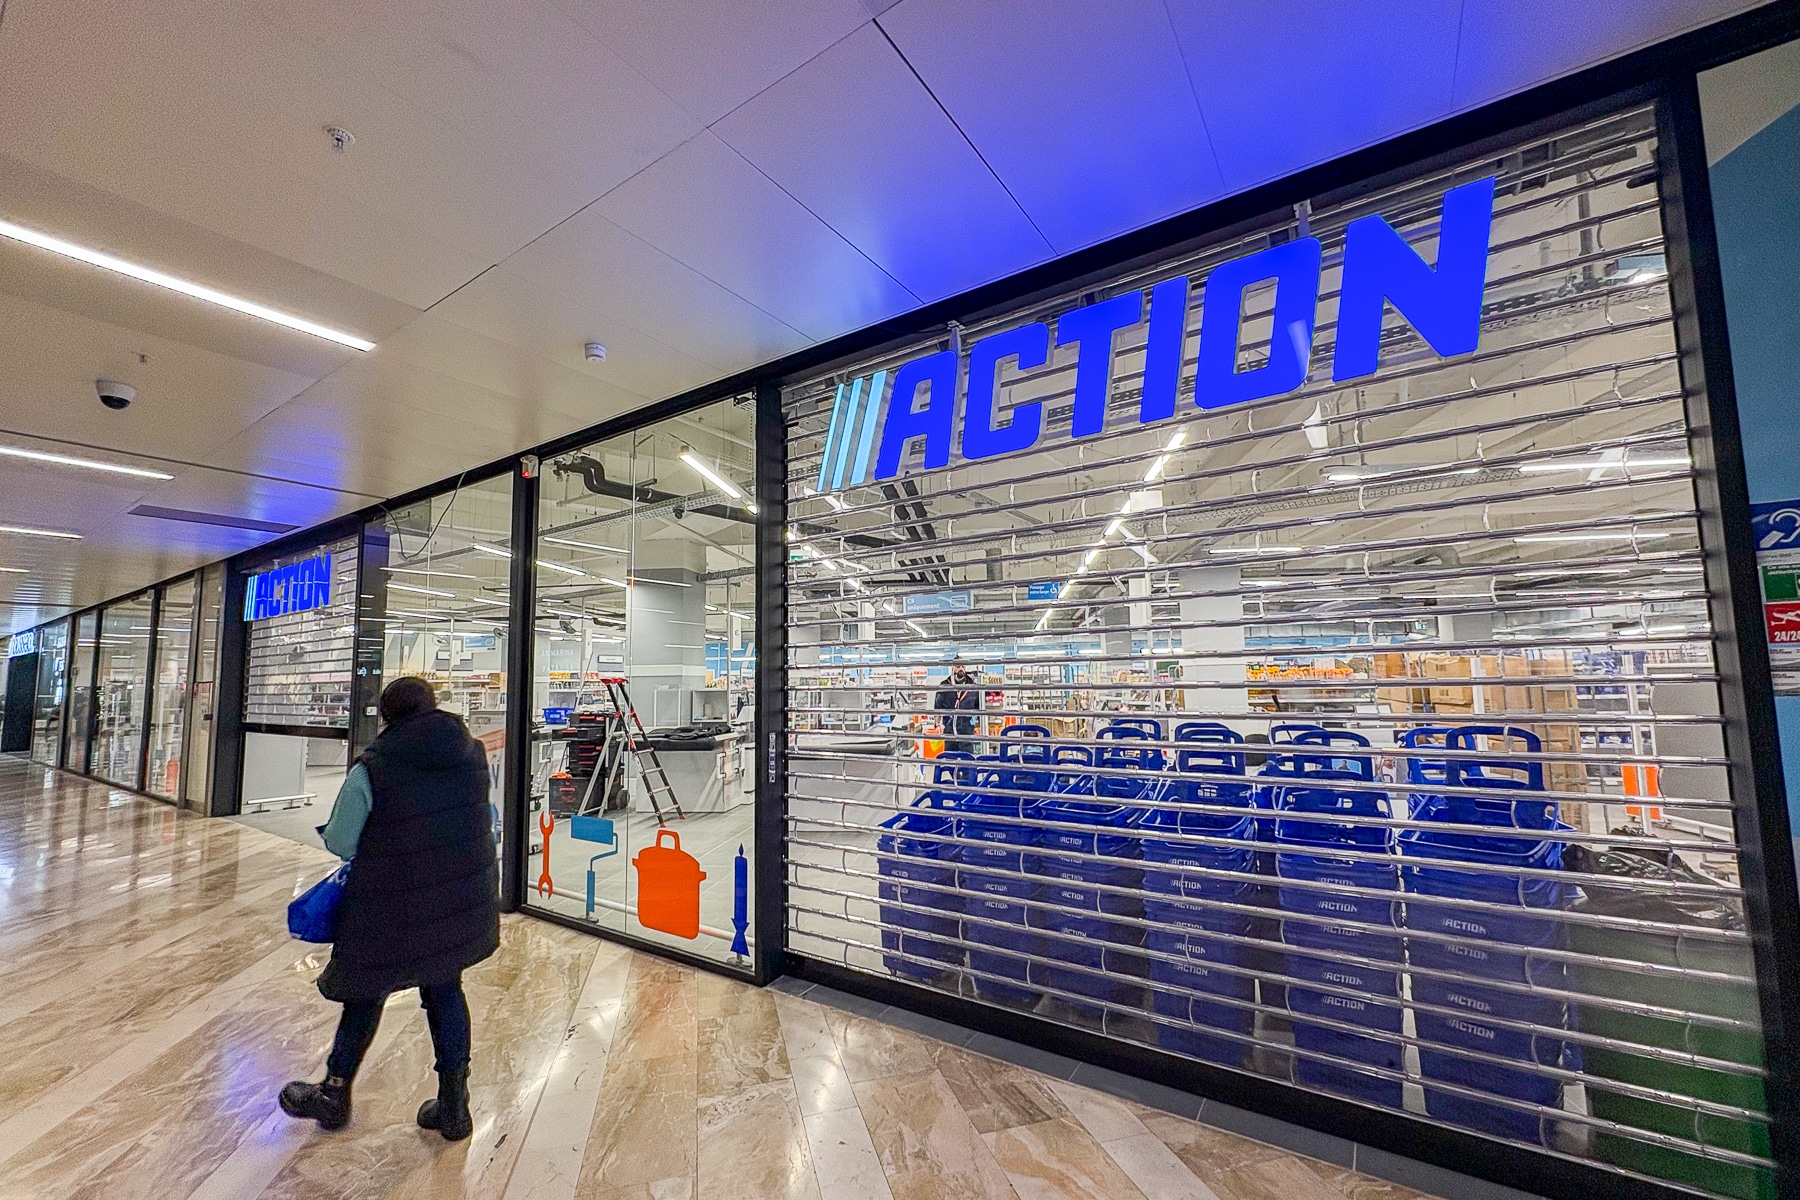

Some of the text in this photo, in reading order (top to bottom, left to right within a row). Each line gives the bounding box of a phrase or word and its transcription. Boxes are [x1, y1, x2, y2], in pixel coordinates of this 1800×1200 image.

[874, 176, 1497, 481] ACTION
[254, 552, 332, 620] ACTION
[907, 602, 941, 611] uniquement
[983, 830, 1007, 840] ACTION
[1060, 836, 1083, 846] ACTION
[984, 848, 1007, 857] ACTION
[986, 883, 1008, 892] ACTION
[1172, 879, 1202, 890] ACTION
[1061, 890, 1084, 901] ACTION
[985, 901, 1009, 910] ACTION
[1320, 900, 1358, 913] ACTION
[1444, 917, 1487, 934] ACTION
[1176, 942, 1206, 954] ACTION
[1446, 943, 1489, 960] ACTION
[1177, 963, 1208, 977] ACTION
[1325, 971, 1363, 986] ACTION
[1326, 995, 1366, 1011] ACTION
[1449, 993, 1493, 1013] ACTION
[1451, 1018, 1495, 1040] ACTION
